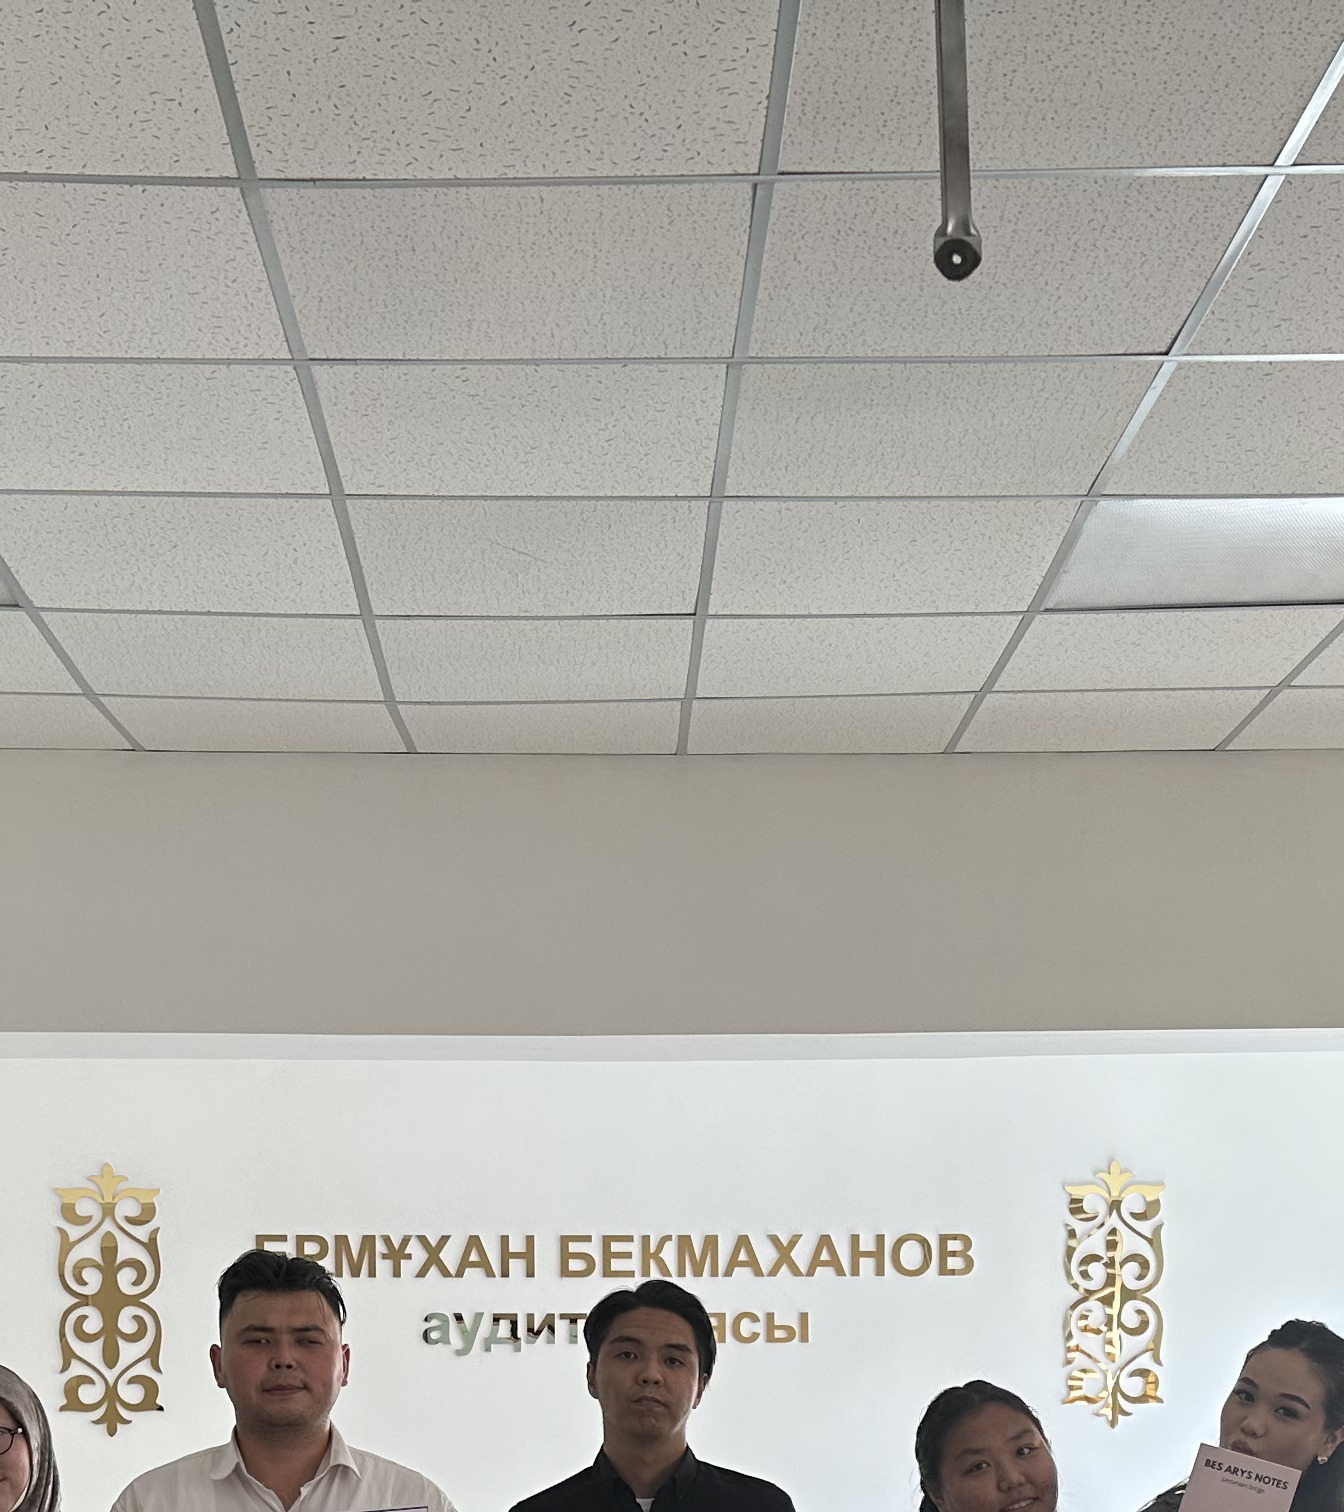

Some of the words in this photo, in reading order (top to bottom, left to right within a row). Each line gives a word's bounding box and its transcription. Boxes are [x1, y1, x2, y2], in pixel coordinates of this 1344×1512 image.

[560, 1233, 976, 1278] БЕКМАХАНОВ
[422, 1311, 810, 1357] аудитясы
[1204, 1459, 1223, 1471] BES
[1224, 1465, 1253, 1480] ARYS
[1254, 1473, 1289, 1490] NOTES
